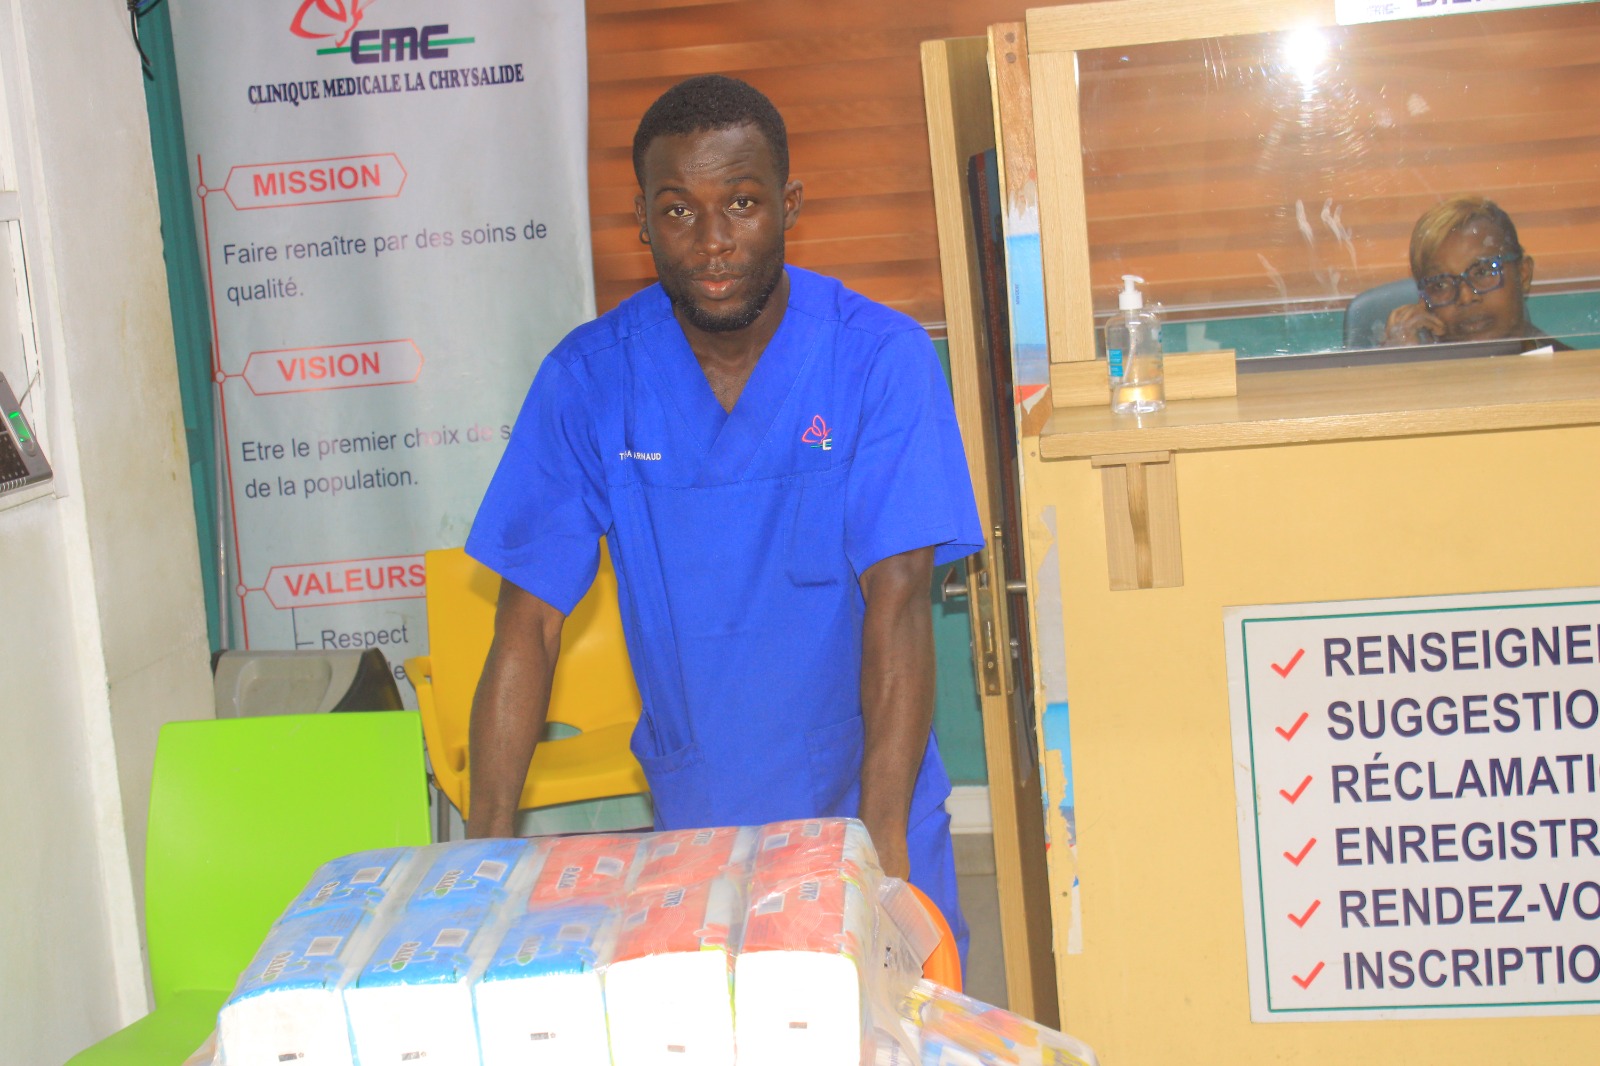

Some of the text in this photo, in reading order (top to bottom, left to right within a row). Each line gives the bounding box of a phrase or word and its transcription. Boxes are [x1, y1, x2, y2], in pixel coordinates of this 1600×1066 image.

[350, 24, 450, 64] CMC
[248, 63, 525, 106] CLINIQUE MEDICALE LA CHRYSALIDE
[253, 164, 382, 197] MISSION
[223, 219, 548, 265] Faire renaître par des soins de
[227, 276, 304, 306] qualité.
[278, 352, 381, 382] VISION
[241, 438, 286, 462] Etre
[291, 436, 311, 457] le
[317, 430, 397, 458] premier
[403, 423, 460, 448] choix
[467, 420, 493, 442] de
[245, 466, 419, 498] de la population.
[284, 564, 427, 597] VALEURS
[321, 625, 409, 650] Respect
[1324, 624, 1600, 676] RENSEIGNE
[1326, 688, 1600, 741] SUGGESTIO
[1330, 751, 1600, 804] RÉCLAMATI
[1335, 818, 1600, 866] ENREGISTR
[1339, 881, 1600, 928] RENDEZ-VO
[1343, 944, 1600, 990] INSCRIPTIO
